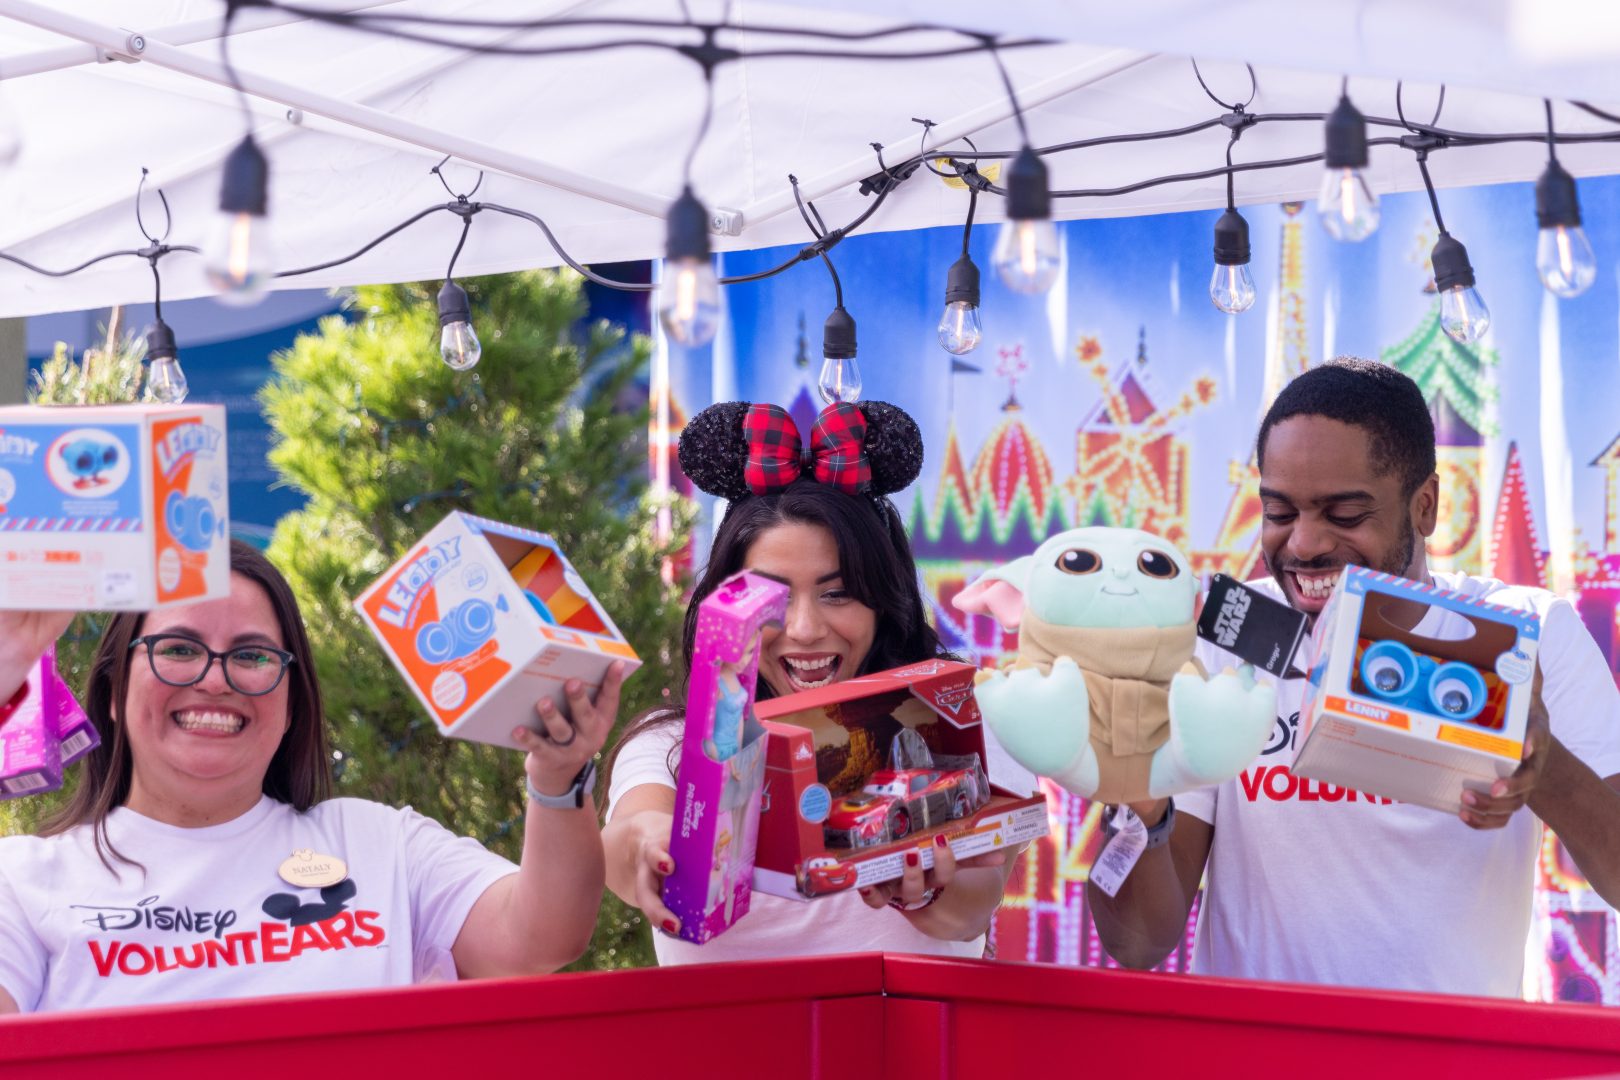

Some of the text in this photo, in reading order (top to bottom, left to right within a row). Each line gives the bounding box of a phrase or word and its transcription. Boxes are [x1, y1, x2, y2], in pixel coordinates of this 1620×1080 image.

[1213, 586, 1246, 645] STAR
[1220, 589, 1252, 648] WARS
[1345, 701, 1390, 720] LENNY
[681, 782, 696, 838] PRINCESS
[87, 910, 386, 977] VOLUNTEARS
